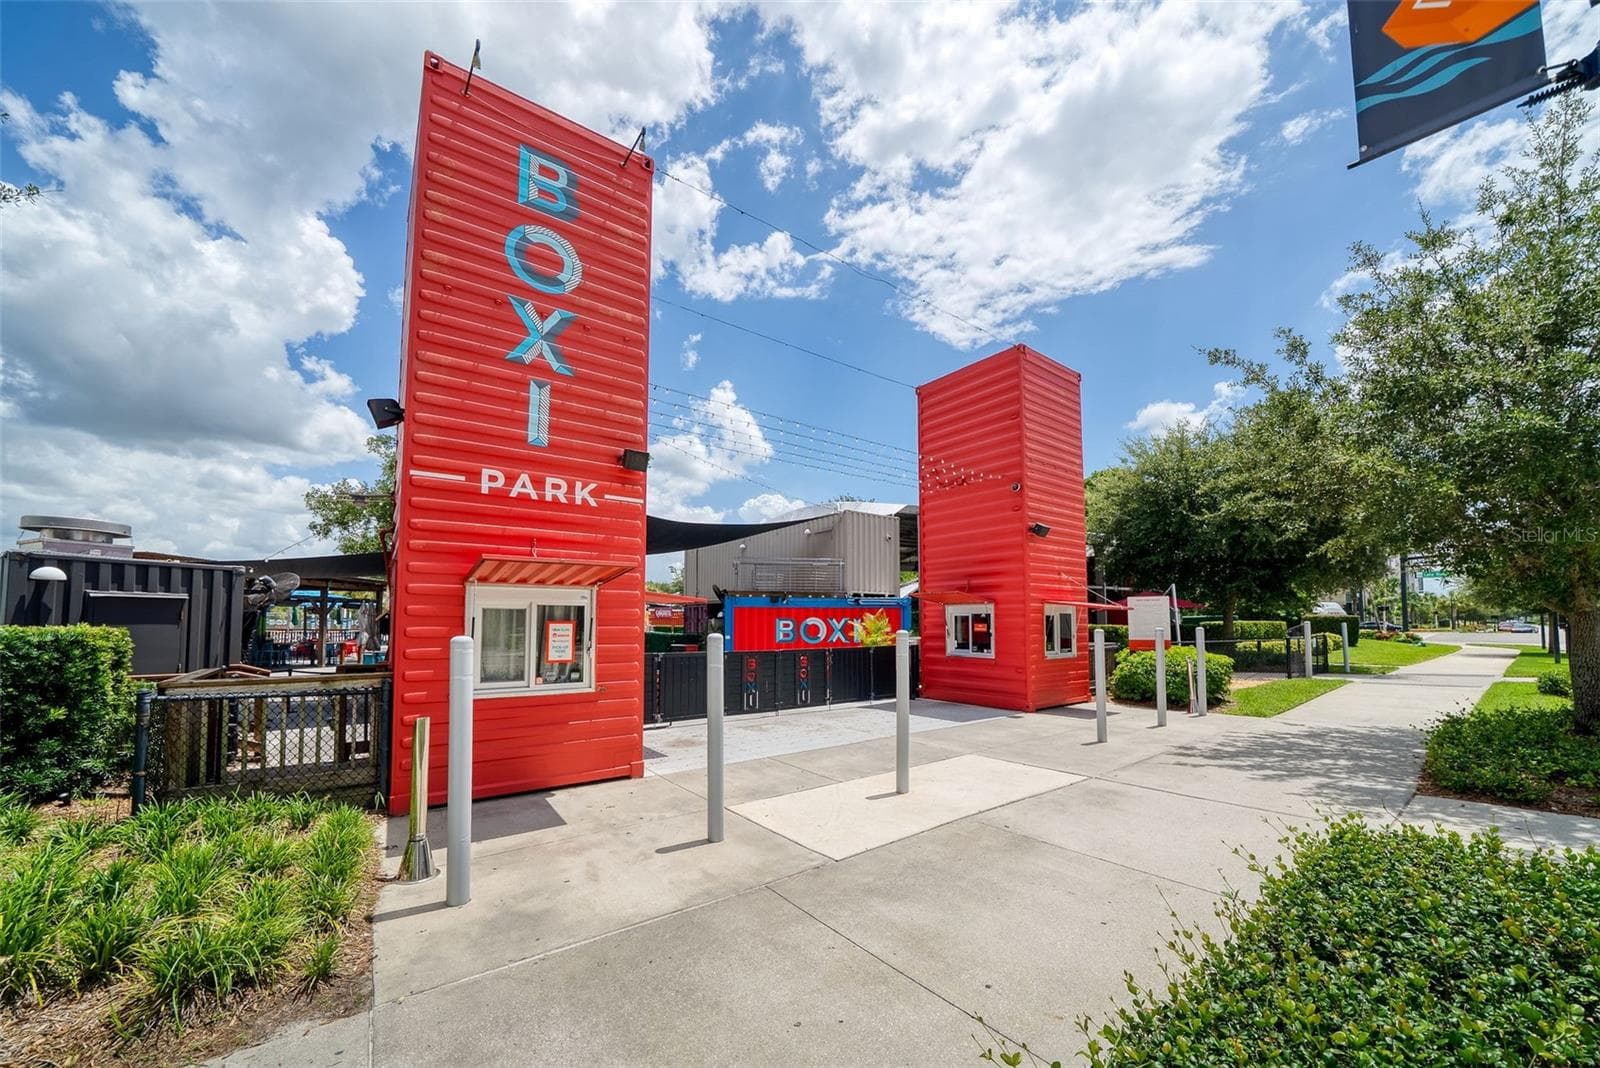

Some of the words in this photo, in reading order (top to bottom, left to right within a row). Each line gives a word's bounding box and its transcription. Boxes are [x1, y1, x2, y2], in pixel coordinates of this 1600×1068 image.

[503, 143, 584, 447] BOXI
[479, 467, 599, 507] PARK
[775, 616, 862, 644] BOXI
